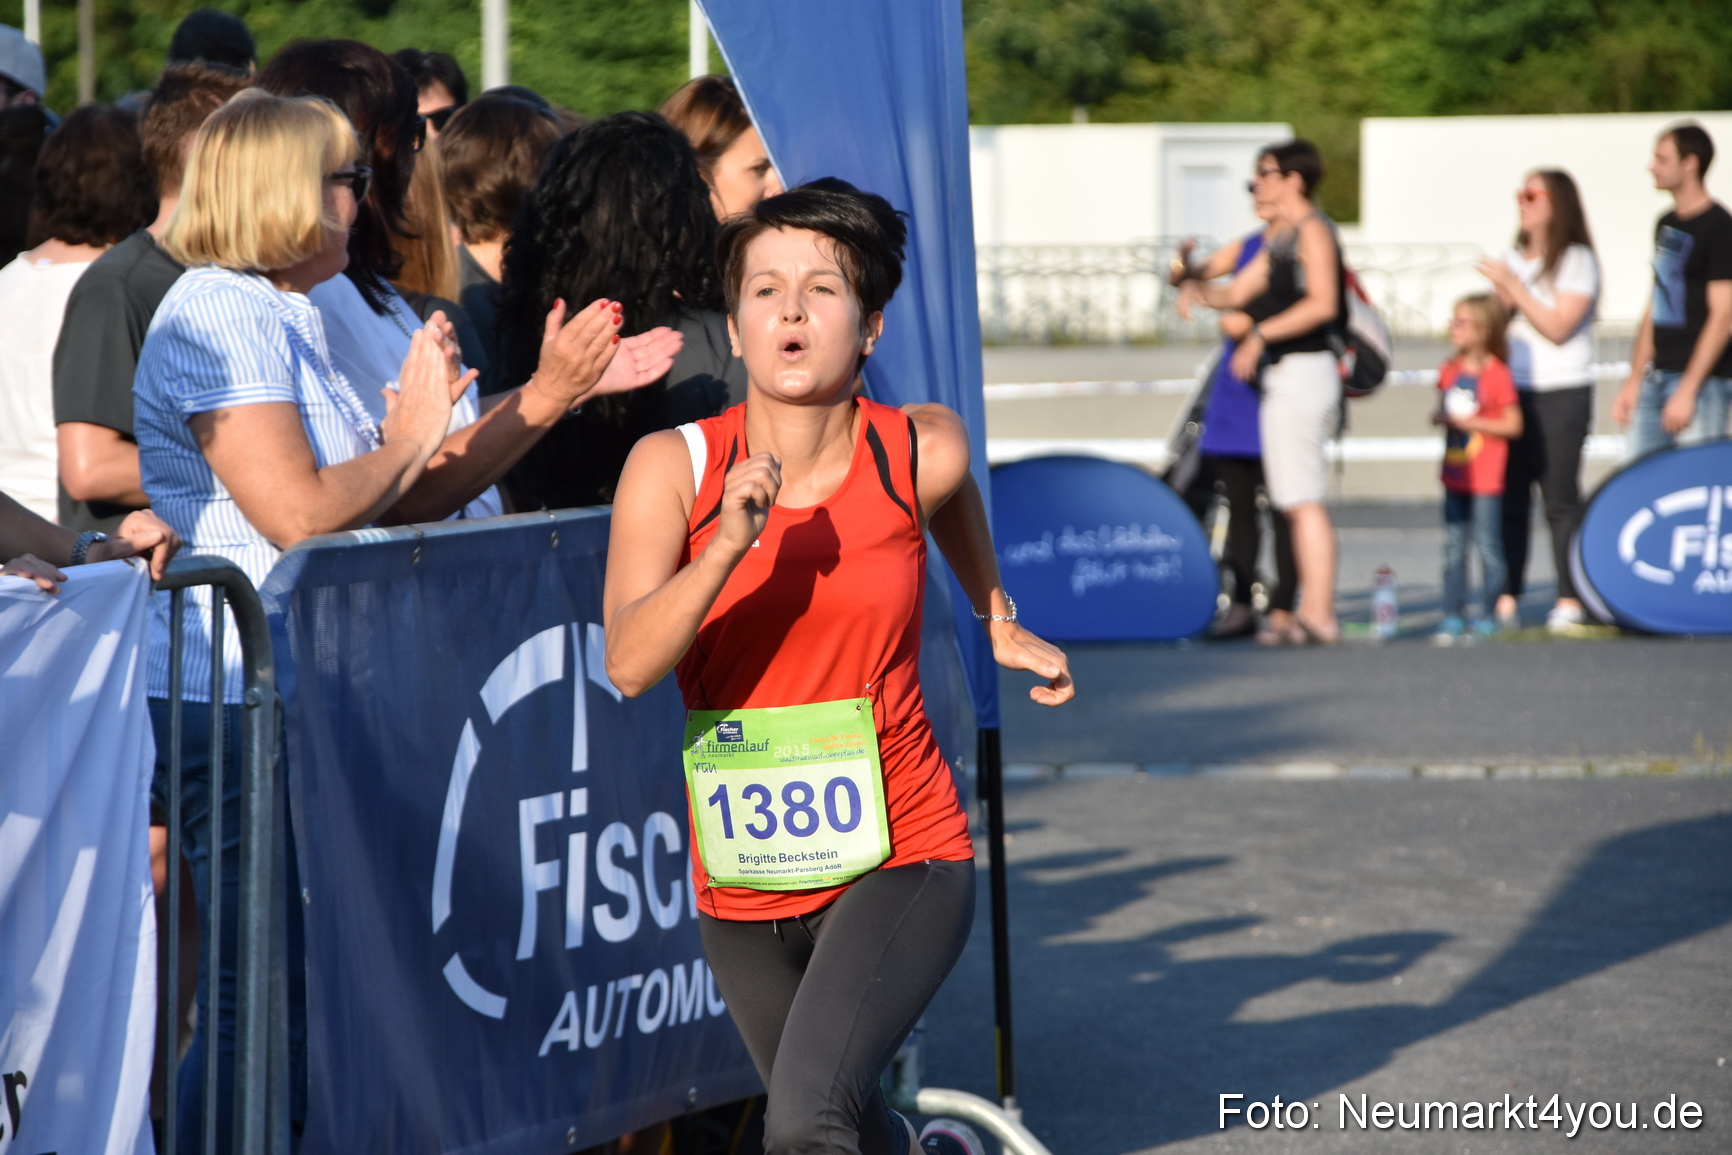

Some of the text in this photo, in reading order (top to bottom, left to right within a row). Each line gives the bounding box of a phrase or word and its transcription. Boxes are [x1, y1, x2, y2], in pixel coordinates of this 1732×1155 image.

[707, 739, 770, 753] firmenlauf
[773, 743, 810, 759] 2015
[708, 776, 862, 840] 1380
[738, 849, 838, 866] Brigitte Beckstein
[515, 787, 697, 961] Fisc
[766, 866, 823, 875] Neumarkt-Parsberg
